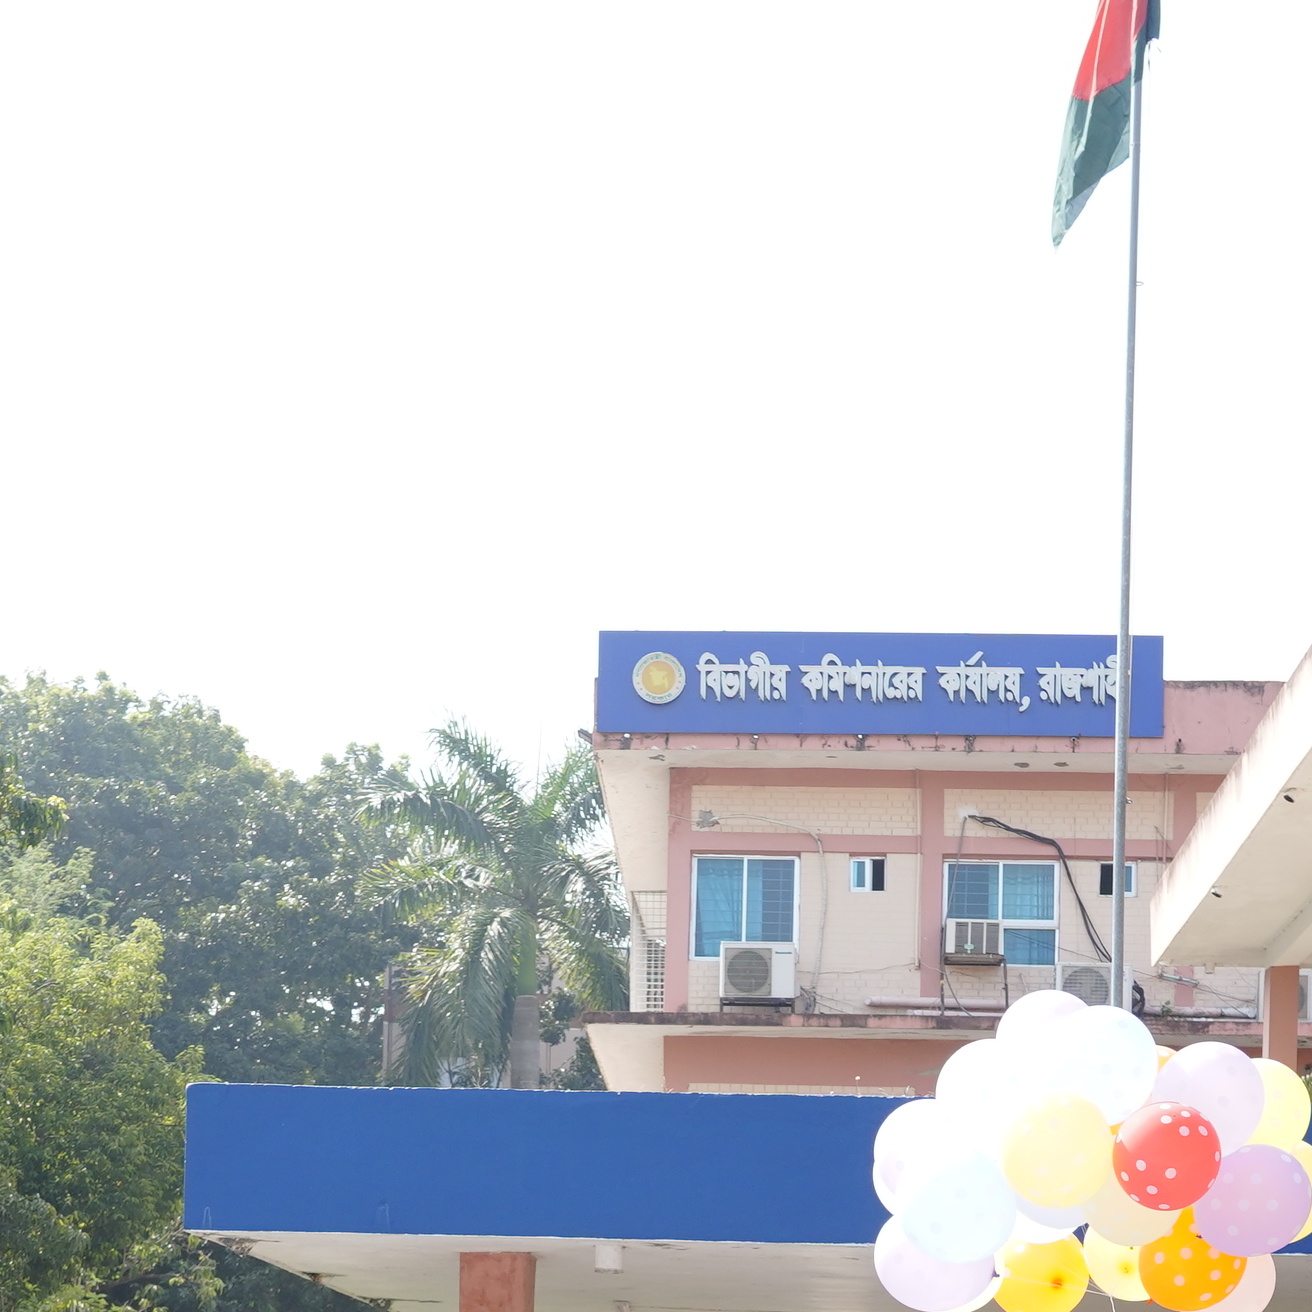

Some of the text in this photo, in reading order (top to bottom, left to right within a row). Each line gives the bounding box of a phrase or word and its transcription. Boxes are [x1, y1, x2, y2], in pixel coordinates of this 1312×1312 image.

[695, 651, 791, 702] বিভাগীয়
[798, 652, 927, 704] কমিশনারের
[1036, 654, 1117, 706] রাজশাহ
